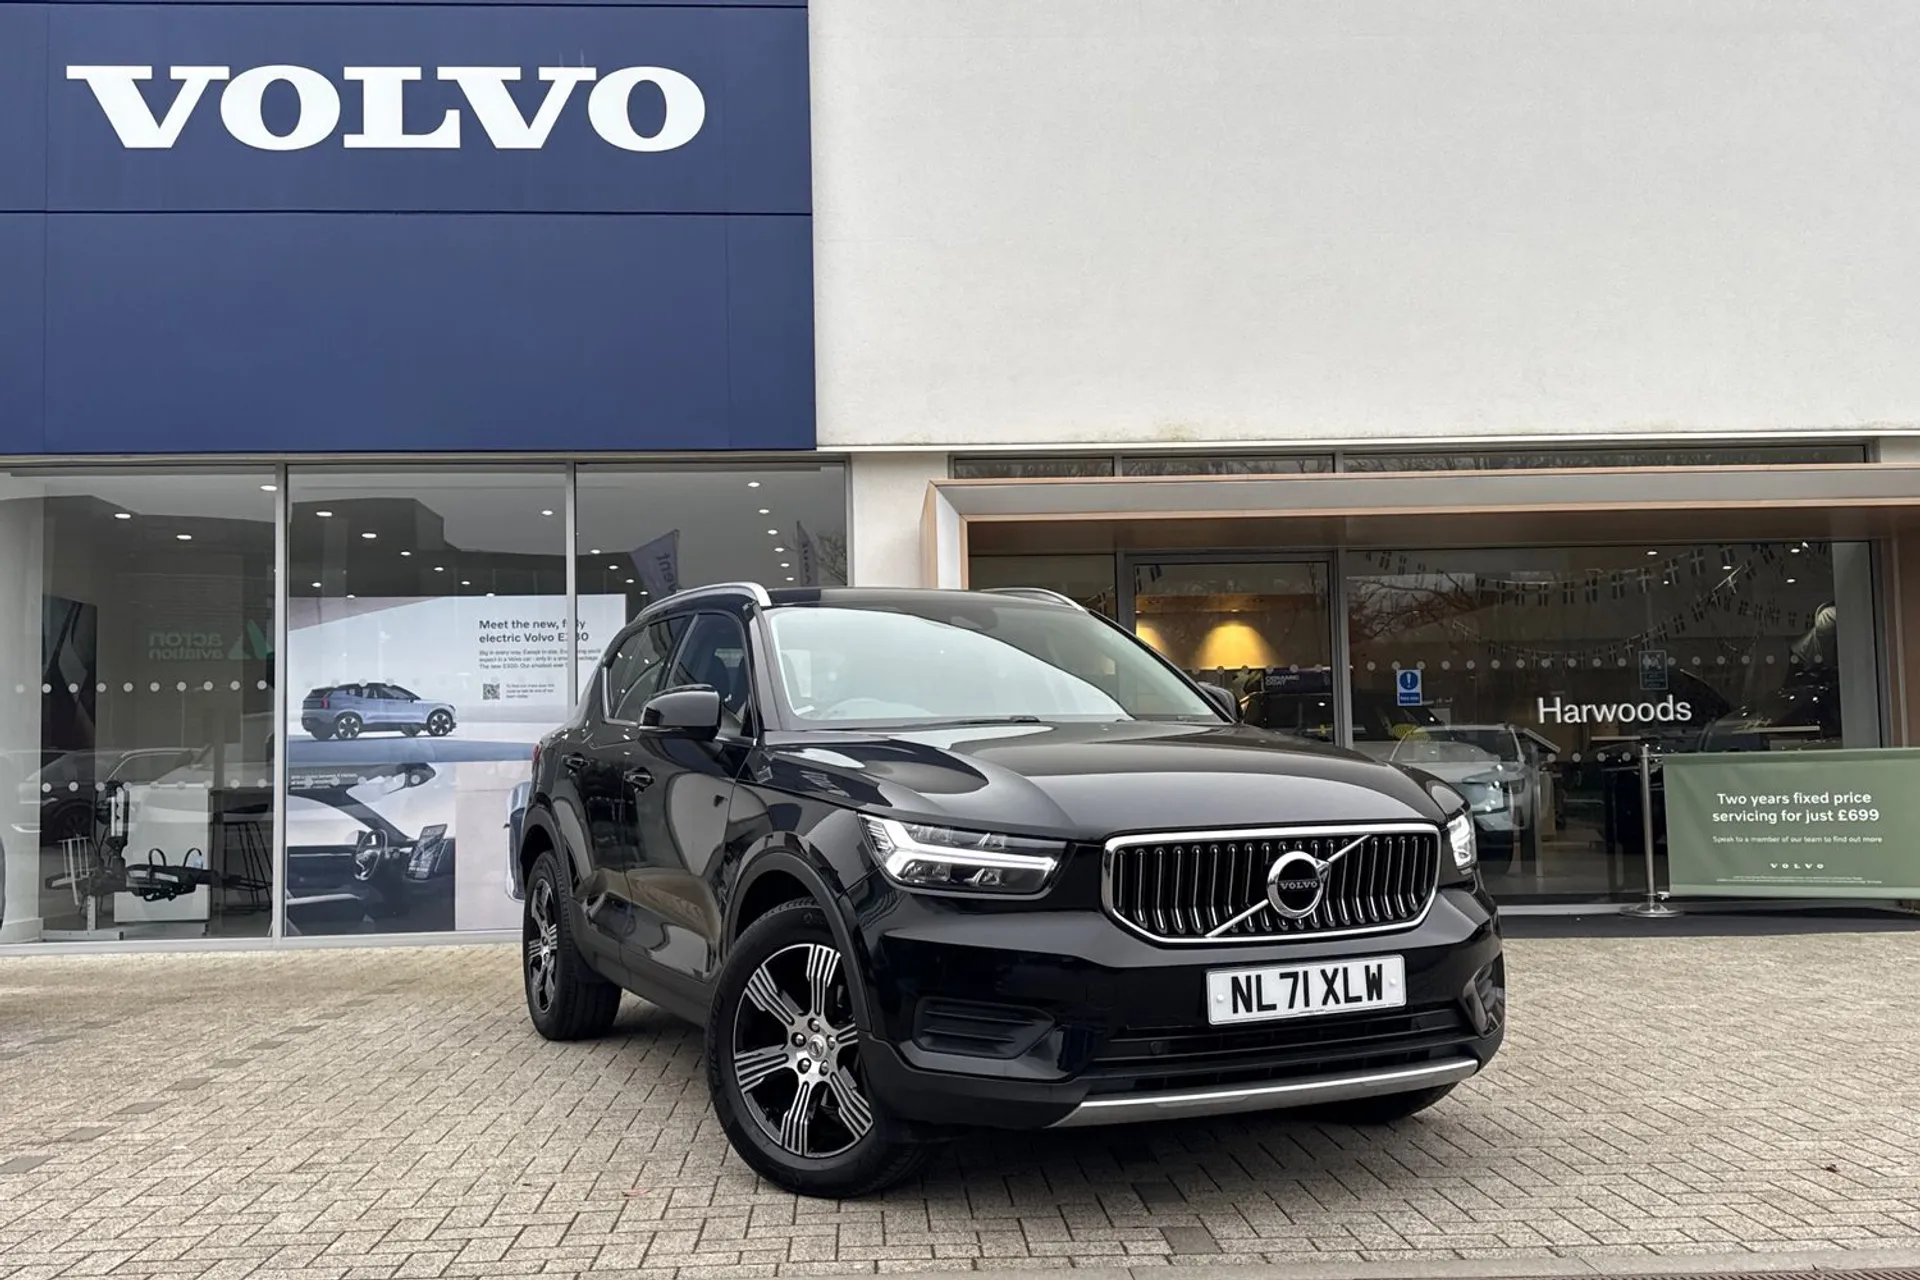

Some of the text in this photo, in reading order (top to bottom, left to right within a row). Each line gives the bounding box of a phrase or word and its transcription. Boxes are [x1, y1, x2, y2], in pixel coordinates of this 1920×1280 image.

[66, 64, 705, 152] VOLVO
[479, 619, 508, 630] Meet
[511, 619, 530, 629] the
[532, 620, 560, 631] new,
[479, 633, 521, 643] electric
[524, 633, 554, 643] Volvo
[1537, 694, 1692, 724] Harwoods
[1716, 792, 1872, 807] Two years fixed price
[1712, 808, 1880, 824] servicing for just £699
[1712, 835, 1733, 844] Speak
[1735, 836, 1744, 844] to
[1750, 835, 1780, 844] member
[1781, 835, 1790, 844] of
[1803, 836, 1822, 844] team
[1833, 835, 1847, 843] find
[1848, 835, 1861, 843] out
[1280, 880, 1318, 890] VOLVO
[1231, 964, 1383, 1014] NL71 XLW
